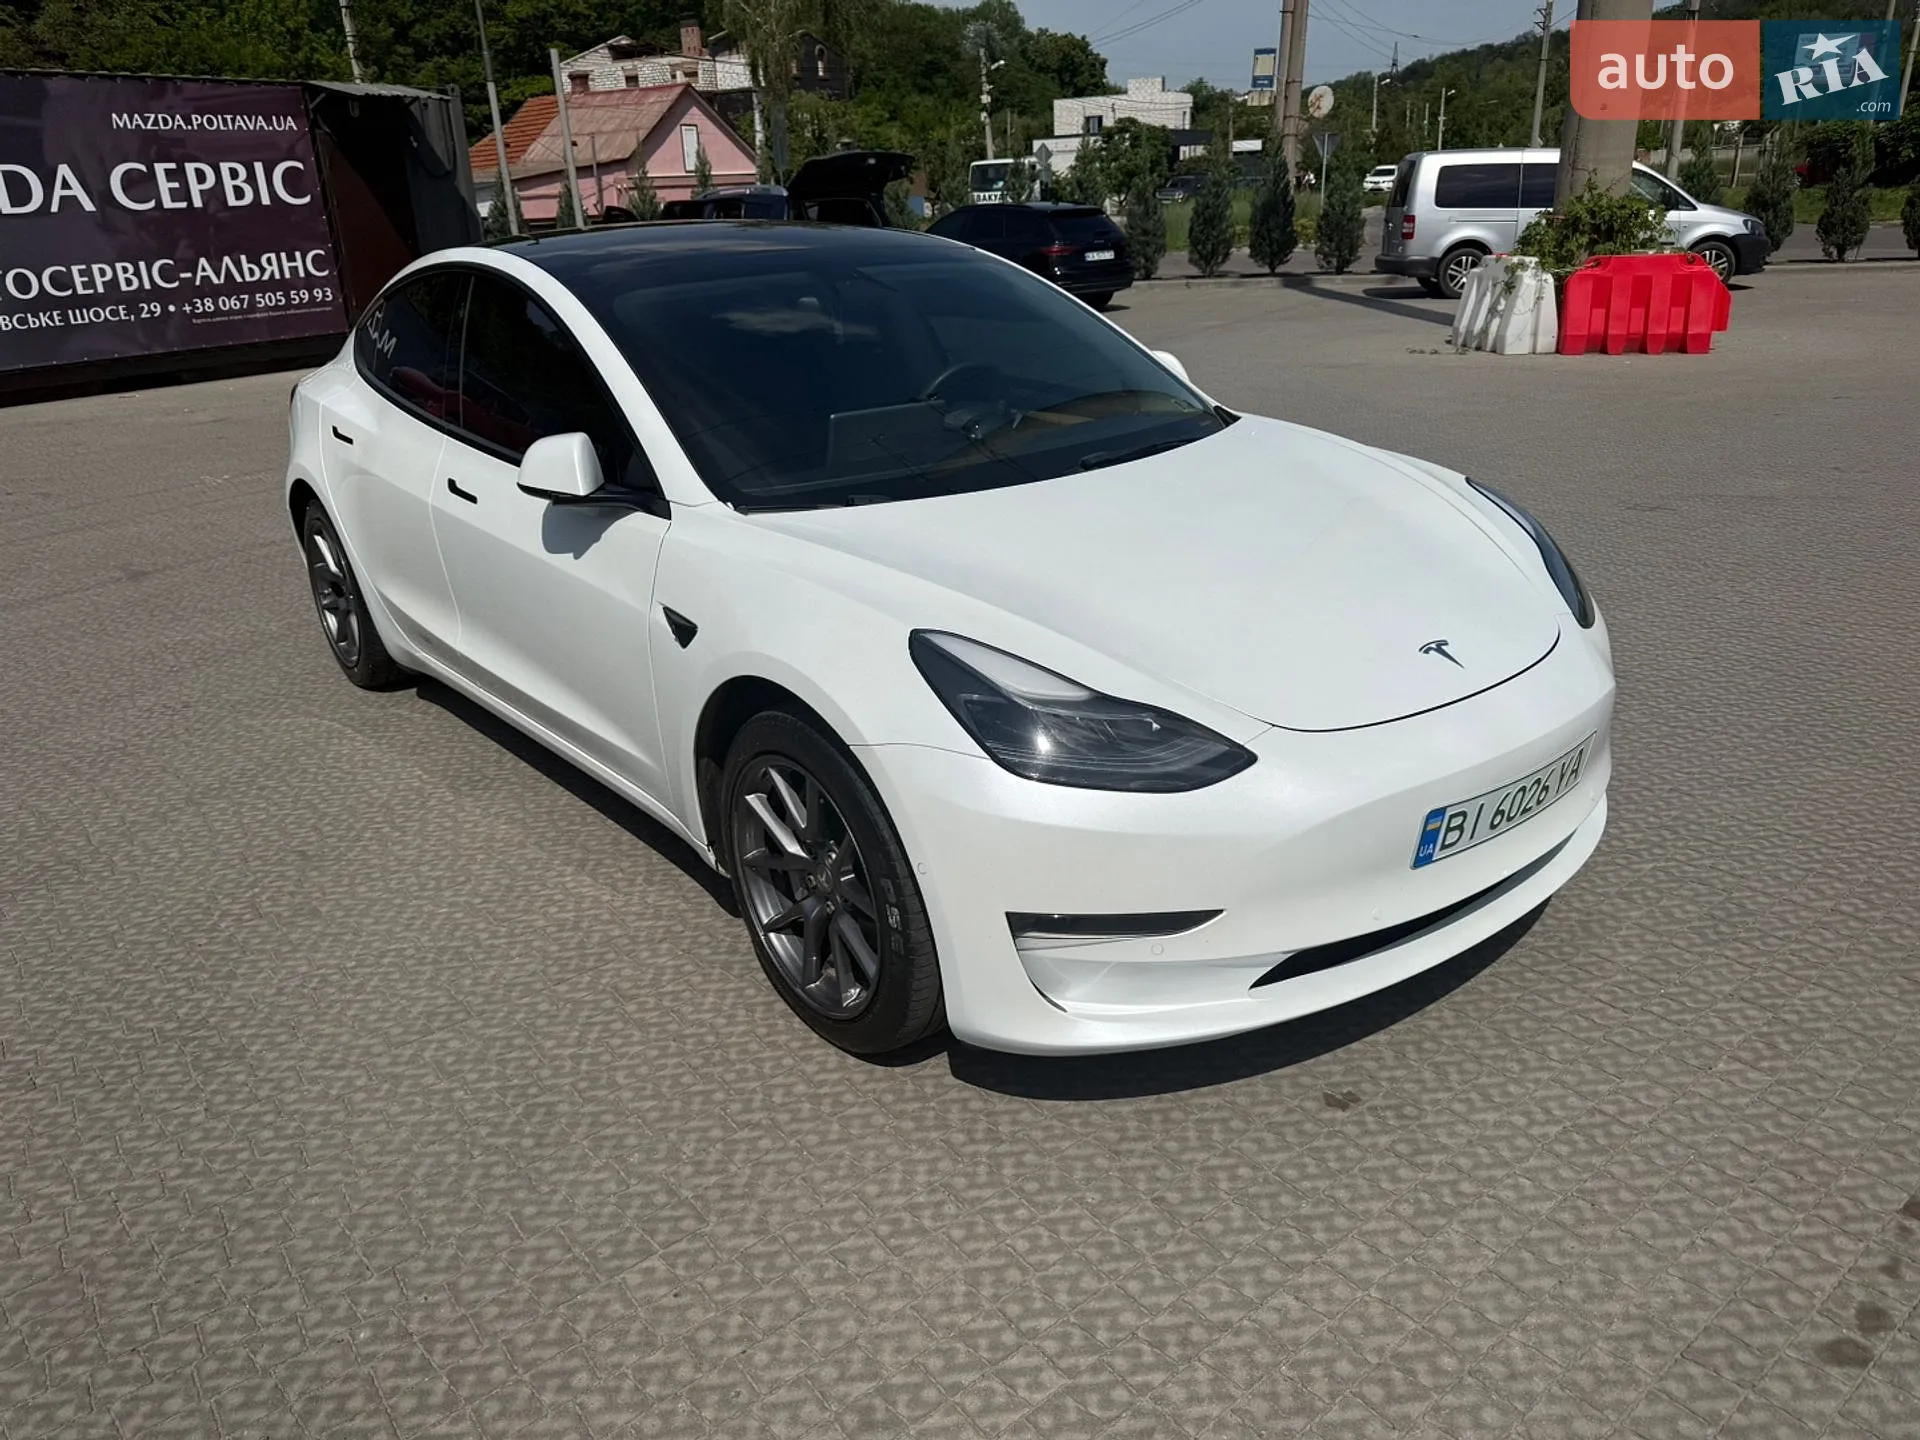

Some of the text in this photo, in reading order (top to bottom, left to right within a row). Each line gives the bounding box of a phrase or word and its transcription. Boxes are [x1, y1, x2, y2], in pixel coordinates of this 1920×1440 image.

[111, 112, 297, 131] MAZDA.POLTAVA.UA
[109, 160, 312, 211] СЕРВІС
[0, 249, 329, 300] ОСЕРВІС-АЛЬЯНС
[68, 304, 135, 323] ШОСЕ,
[138, 302, 161, 318] 29
[182, 297, 215, 314] +38
[218, 294, 249, 311] 067
[255, 291, 286, 308] 505
[290, 289, 309, 305] 59
[313, 287, 333, 302] 93
[1440, 746, 1585, 850] BI 6026 YA
[1419, 843, 1434, 857] UA
